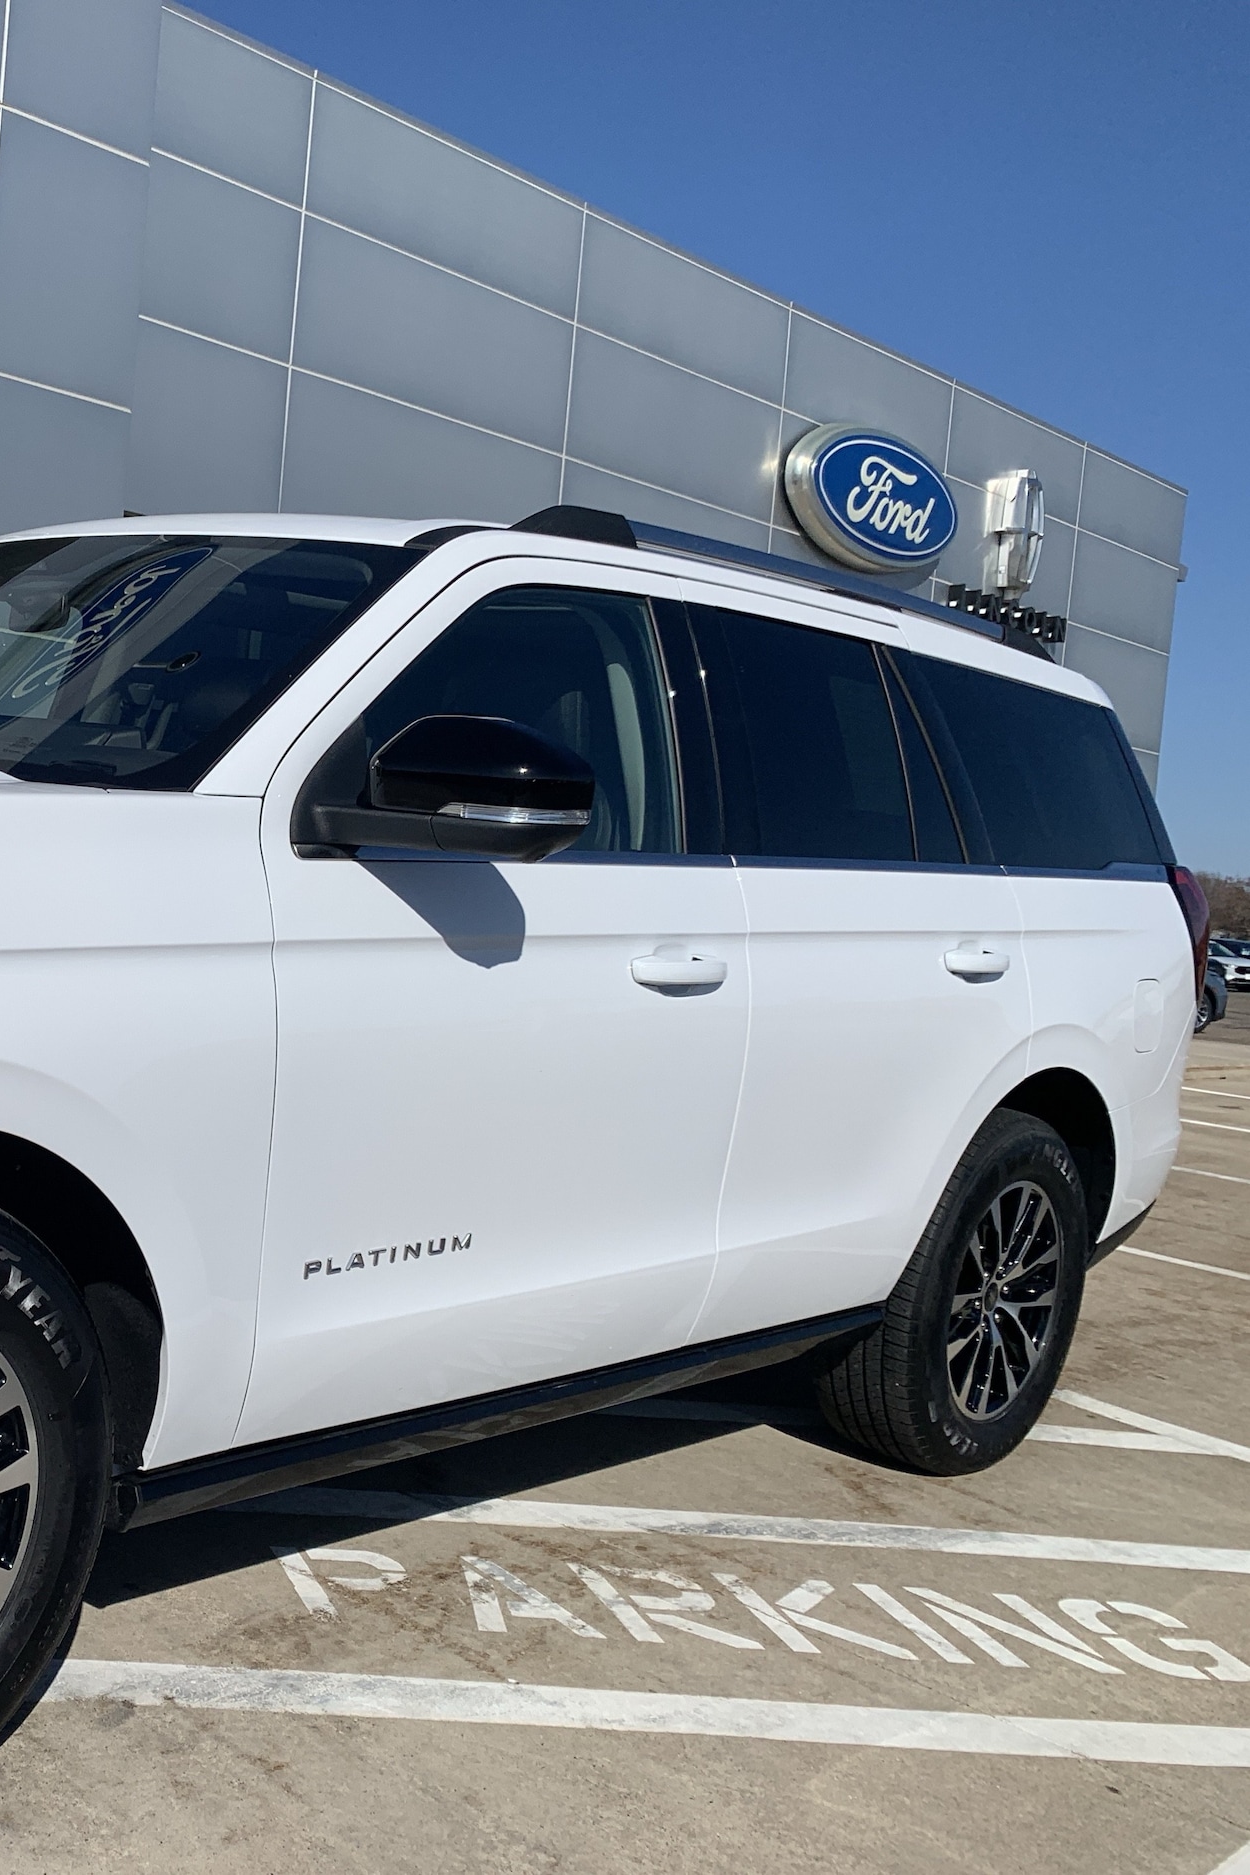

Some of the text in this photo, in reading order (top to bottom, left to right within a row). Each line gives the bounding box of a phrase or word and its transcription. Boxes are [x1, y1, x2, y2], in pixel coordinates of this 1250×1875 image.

[847, 456, 935, 544] Ford
[303, 1233, 472, 1280] PLATINUM
[270, 1546, 1250, 1682] PARKING
